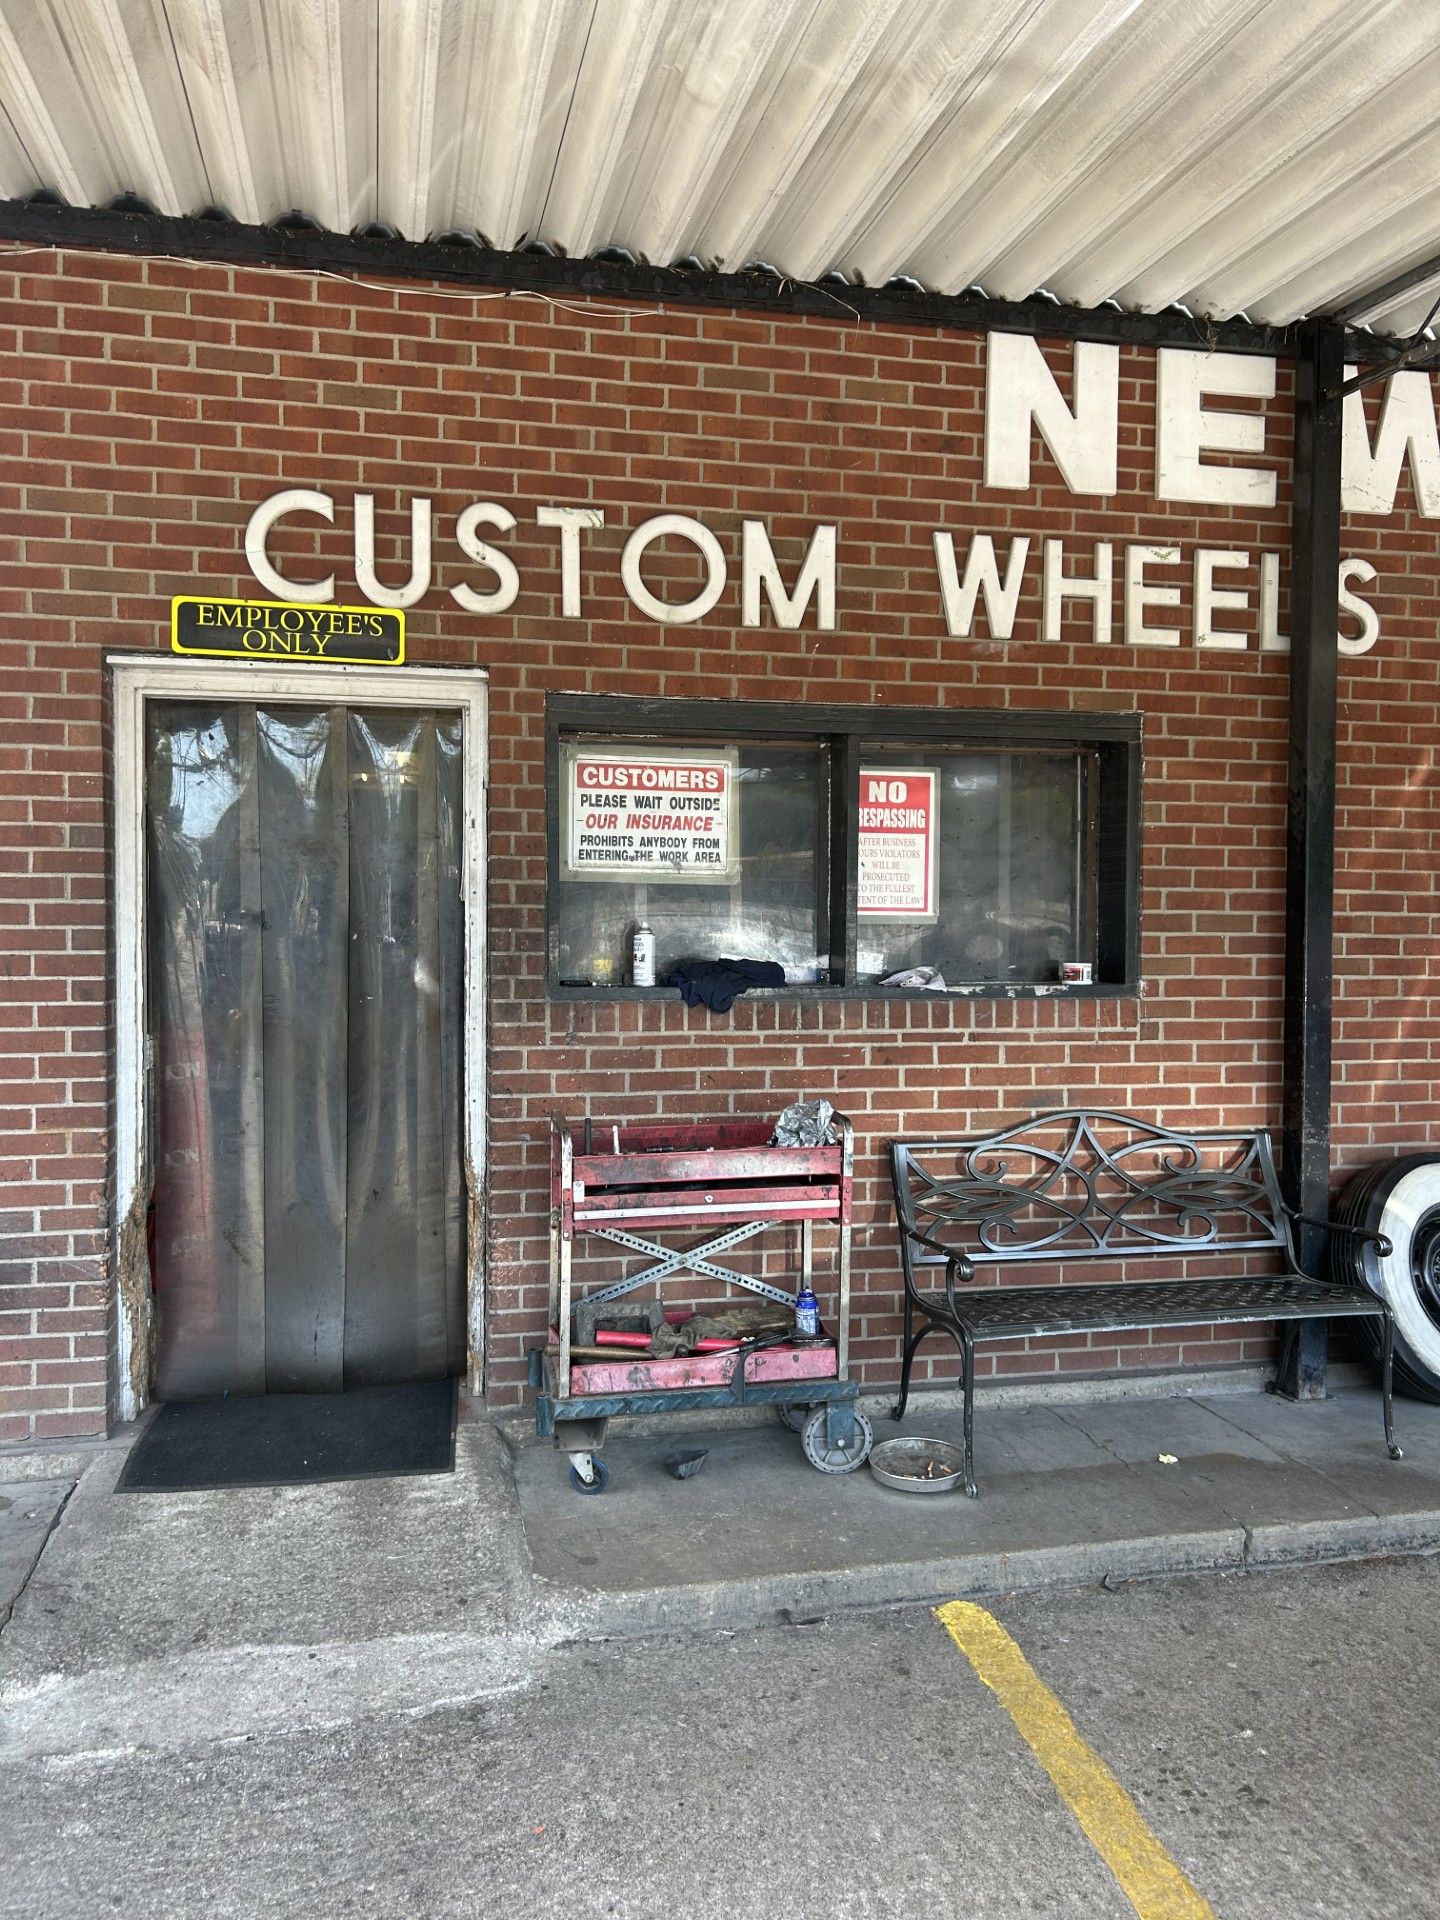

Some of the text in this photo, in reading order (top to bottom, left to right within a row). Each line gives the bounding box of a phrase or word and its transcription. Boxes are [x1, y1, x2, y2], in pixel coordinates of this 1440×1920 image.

[983, 331, 1440, 519] NEW
[244, 488, 1381, 656] CUSTOM WHEELS
[196, 604, 383, 637] EMPLOYEE'S
[243, 629, 332, 655] ONLY
[582, 767, 719, 789] CUSTOMERS
[868, 781, 908, 804] NO
[580, 794, 720, 811] PLEASE WAIT OUTSIDE
[585, 813, 714, 831] OUR INSURANCE
[859, 808, 926, 829] RESPASSING
[580, 835, 720, 849] PROHIBITS ANYBODY FROM
[858, 838, 916, 847] AFTER BUSINESS
[578, 849, 721, 863] ENTERING THE WORK AREA
[858, 849, 920, 858] OURS VIOLATORS
[872, 861, 890, 869] WILL
[862, 873, 910, 881] PROSECUTED
[869, 884, 884, 893] THE
[885, 884, 915, 893] FULLEST
[858, 896, 877, 904] TENT
[877, 896, 887, 904] OF
[889, 896, 904, 904] THE
